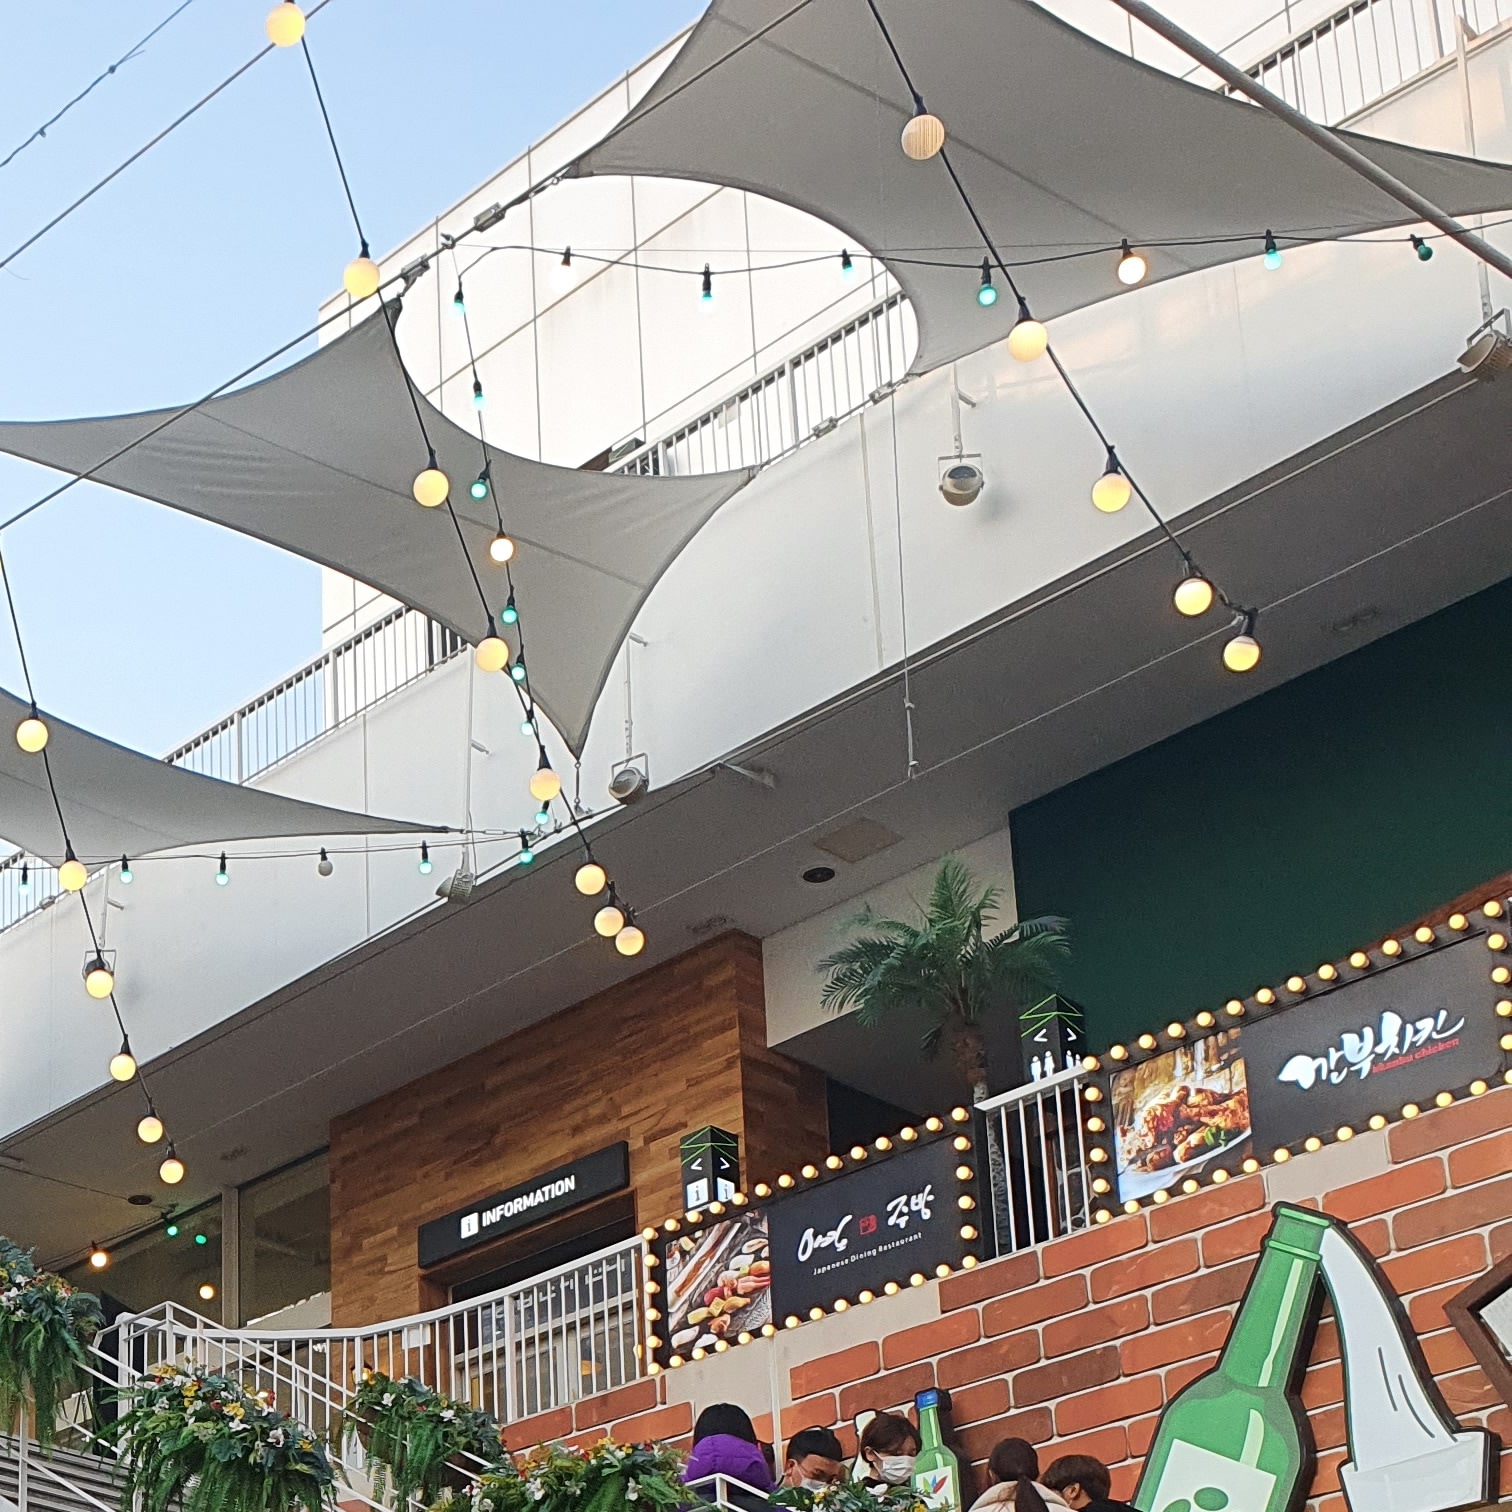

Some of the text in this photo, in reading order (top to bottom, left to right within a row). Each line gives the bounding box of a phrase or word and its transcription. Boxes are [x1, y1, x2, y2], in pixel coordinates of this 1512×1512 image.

[1277, 1008, 1465, 1089] 깐부치킨
[482, 1175, 576, 1227] INFORMATION
[887, 1184, 935, 1229] 주방
[813, 1232, 923, 1275] Japanese Dining Restaurant
